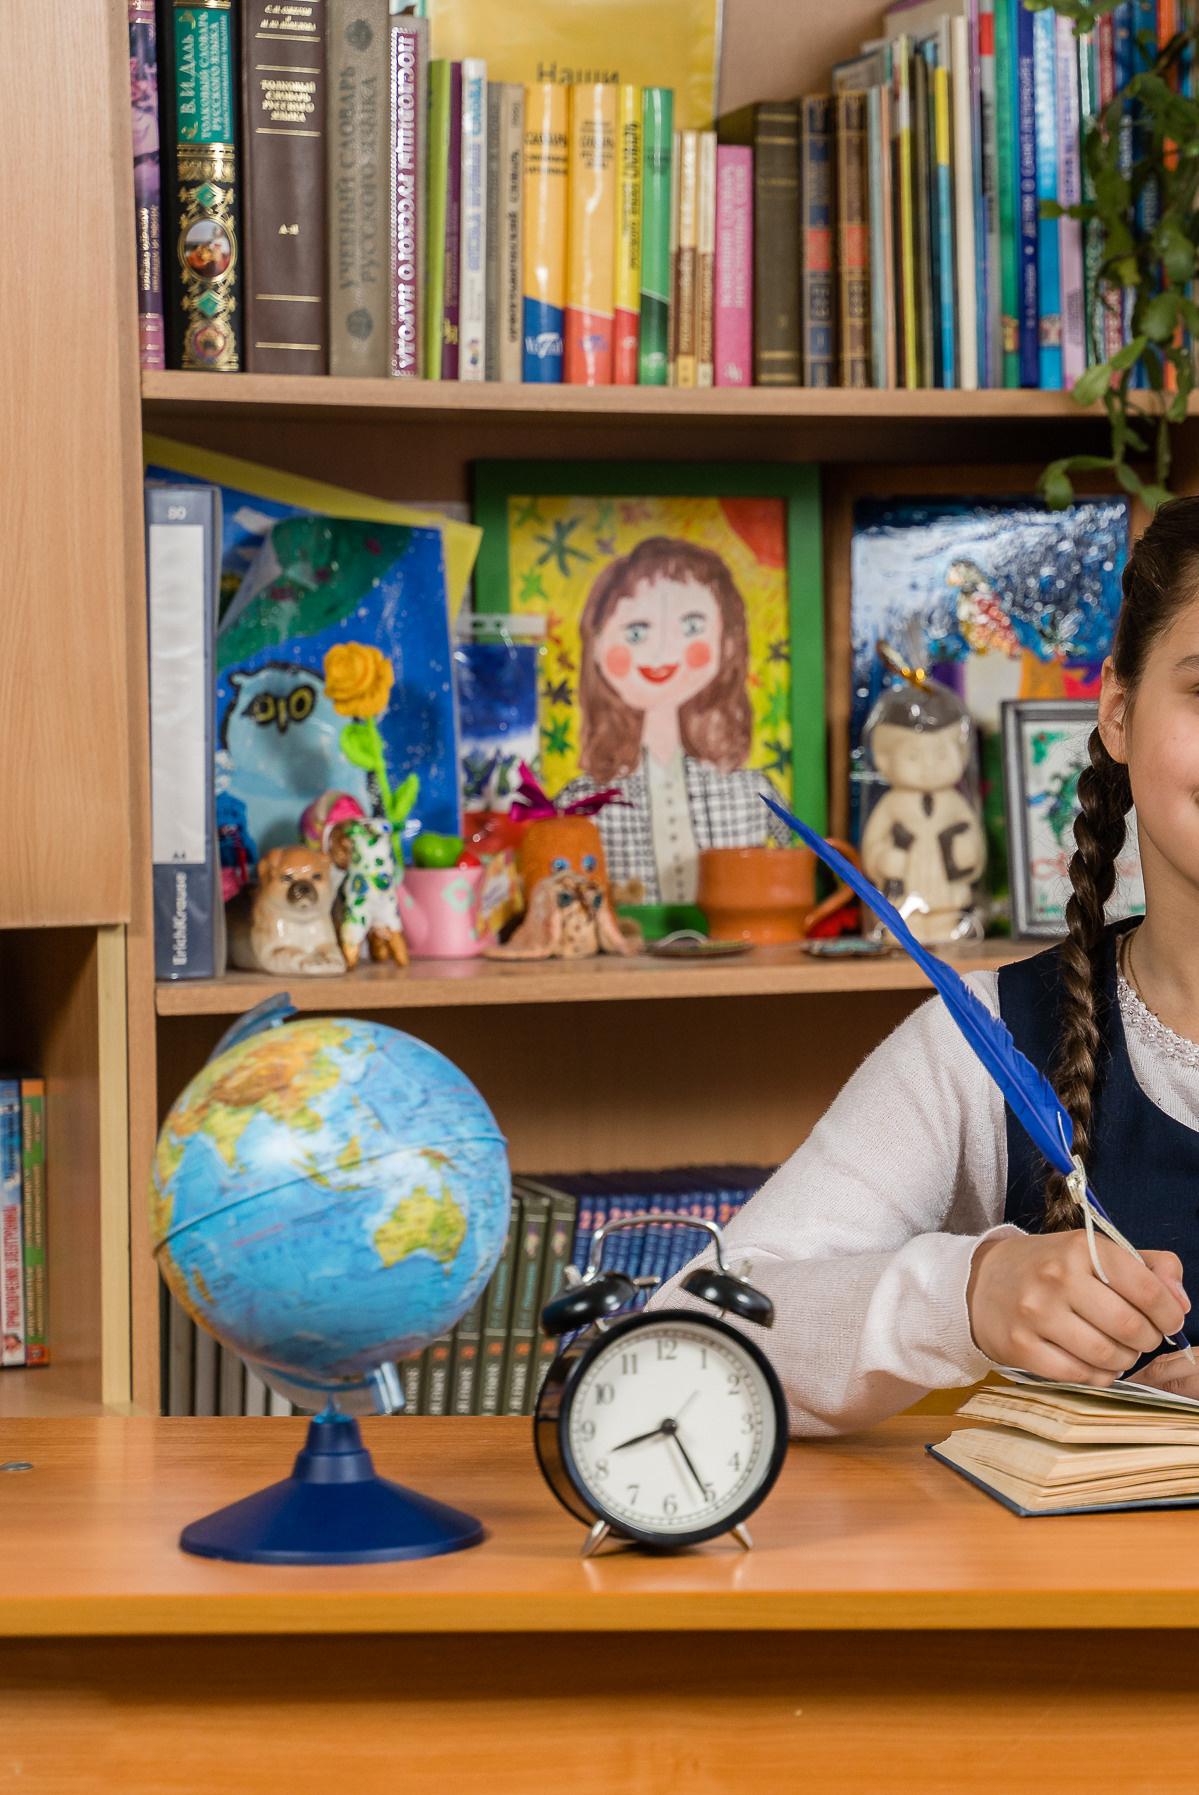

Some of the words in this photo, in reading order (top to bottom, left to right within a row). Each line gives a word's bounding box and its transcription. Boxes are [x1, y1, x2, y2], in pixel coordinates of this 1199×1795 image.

[197, 12, 210, 68] СЛОВАРЬ
[209, 22, 220, 65] ЯЗЫКА
[536, 60, 620, 86] Наши
[198, 69, 211, 139] ТОЛКОВЫЙ
[210, 66, 223, 131] РУССКОГО
[395, 35, 416, 170] ПОСЛОВИЦЫ
[338, 66, 355, 169] СЛОВАРЬ
[360, 77, 377, 153] ЯЗЫКА
[337, 177, 356, 290] УЧЕБНЫЙ
[360, 164, 379, 283] РУССКОГО
[397, 173, 415, 280] РУССКОГО
[395, 284, 416, 369] НАРОДА
[172, 871, 188, 966] ErichKrause
[656, 1338, 677, 1360] 12
[700, 1348, 708, 1369] 1
[622, 1353, 638, 1375] 11
[595, 1383, 614, 1405] 10
[728, 1375, 741, 1395] 2
[581, 1421, 595, 1442] 9
[741, 1413, 755, 1434] 3
[595, 1457, 609, 1480] 8
[728, 1452, 741, 1471] 4
[627, 1484, 640, 1506] 7
[663, 1494, 677, 1516] 6
[704, 1482, 716, 1502] 5
